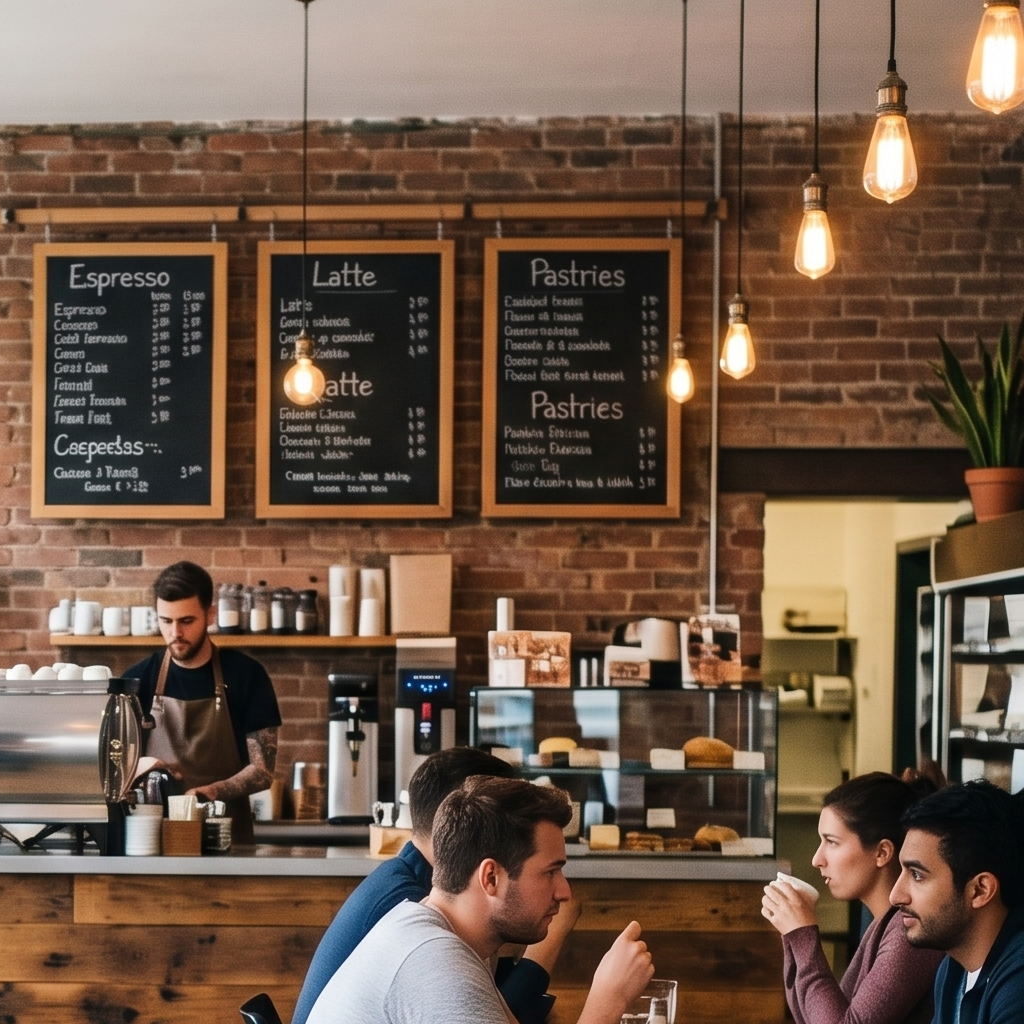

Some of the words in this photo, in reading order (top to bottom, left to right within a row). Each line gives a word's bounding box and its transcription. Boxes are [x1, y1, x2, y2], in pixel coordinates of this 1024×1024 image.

[69, 263, 170, 297] Espresso
[312, 260, 377, 287] Latte
[531, 257, 626, 287] Pastries
[326, 371, 374, 397] atte
[531, 390, 624, 420] Pastries
